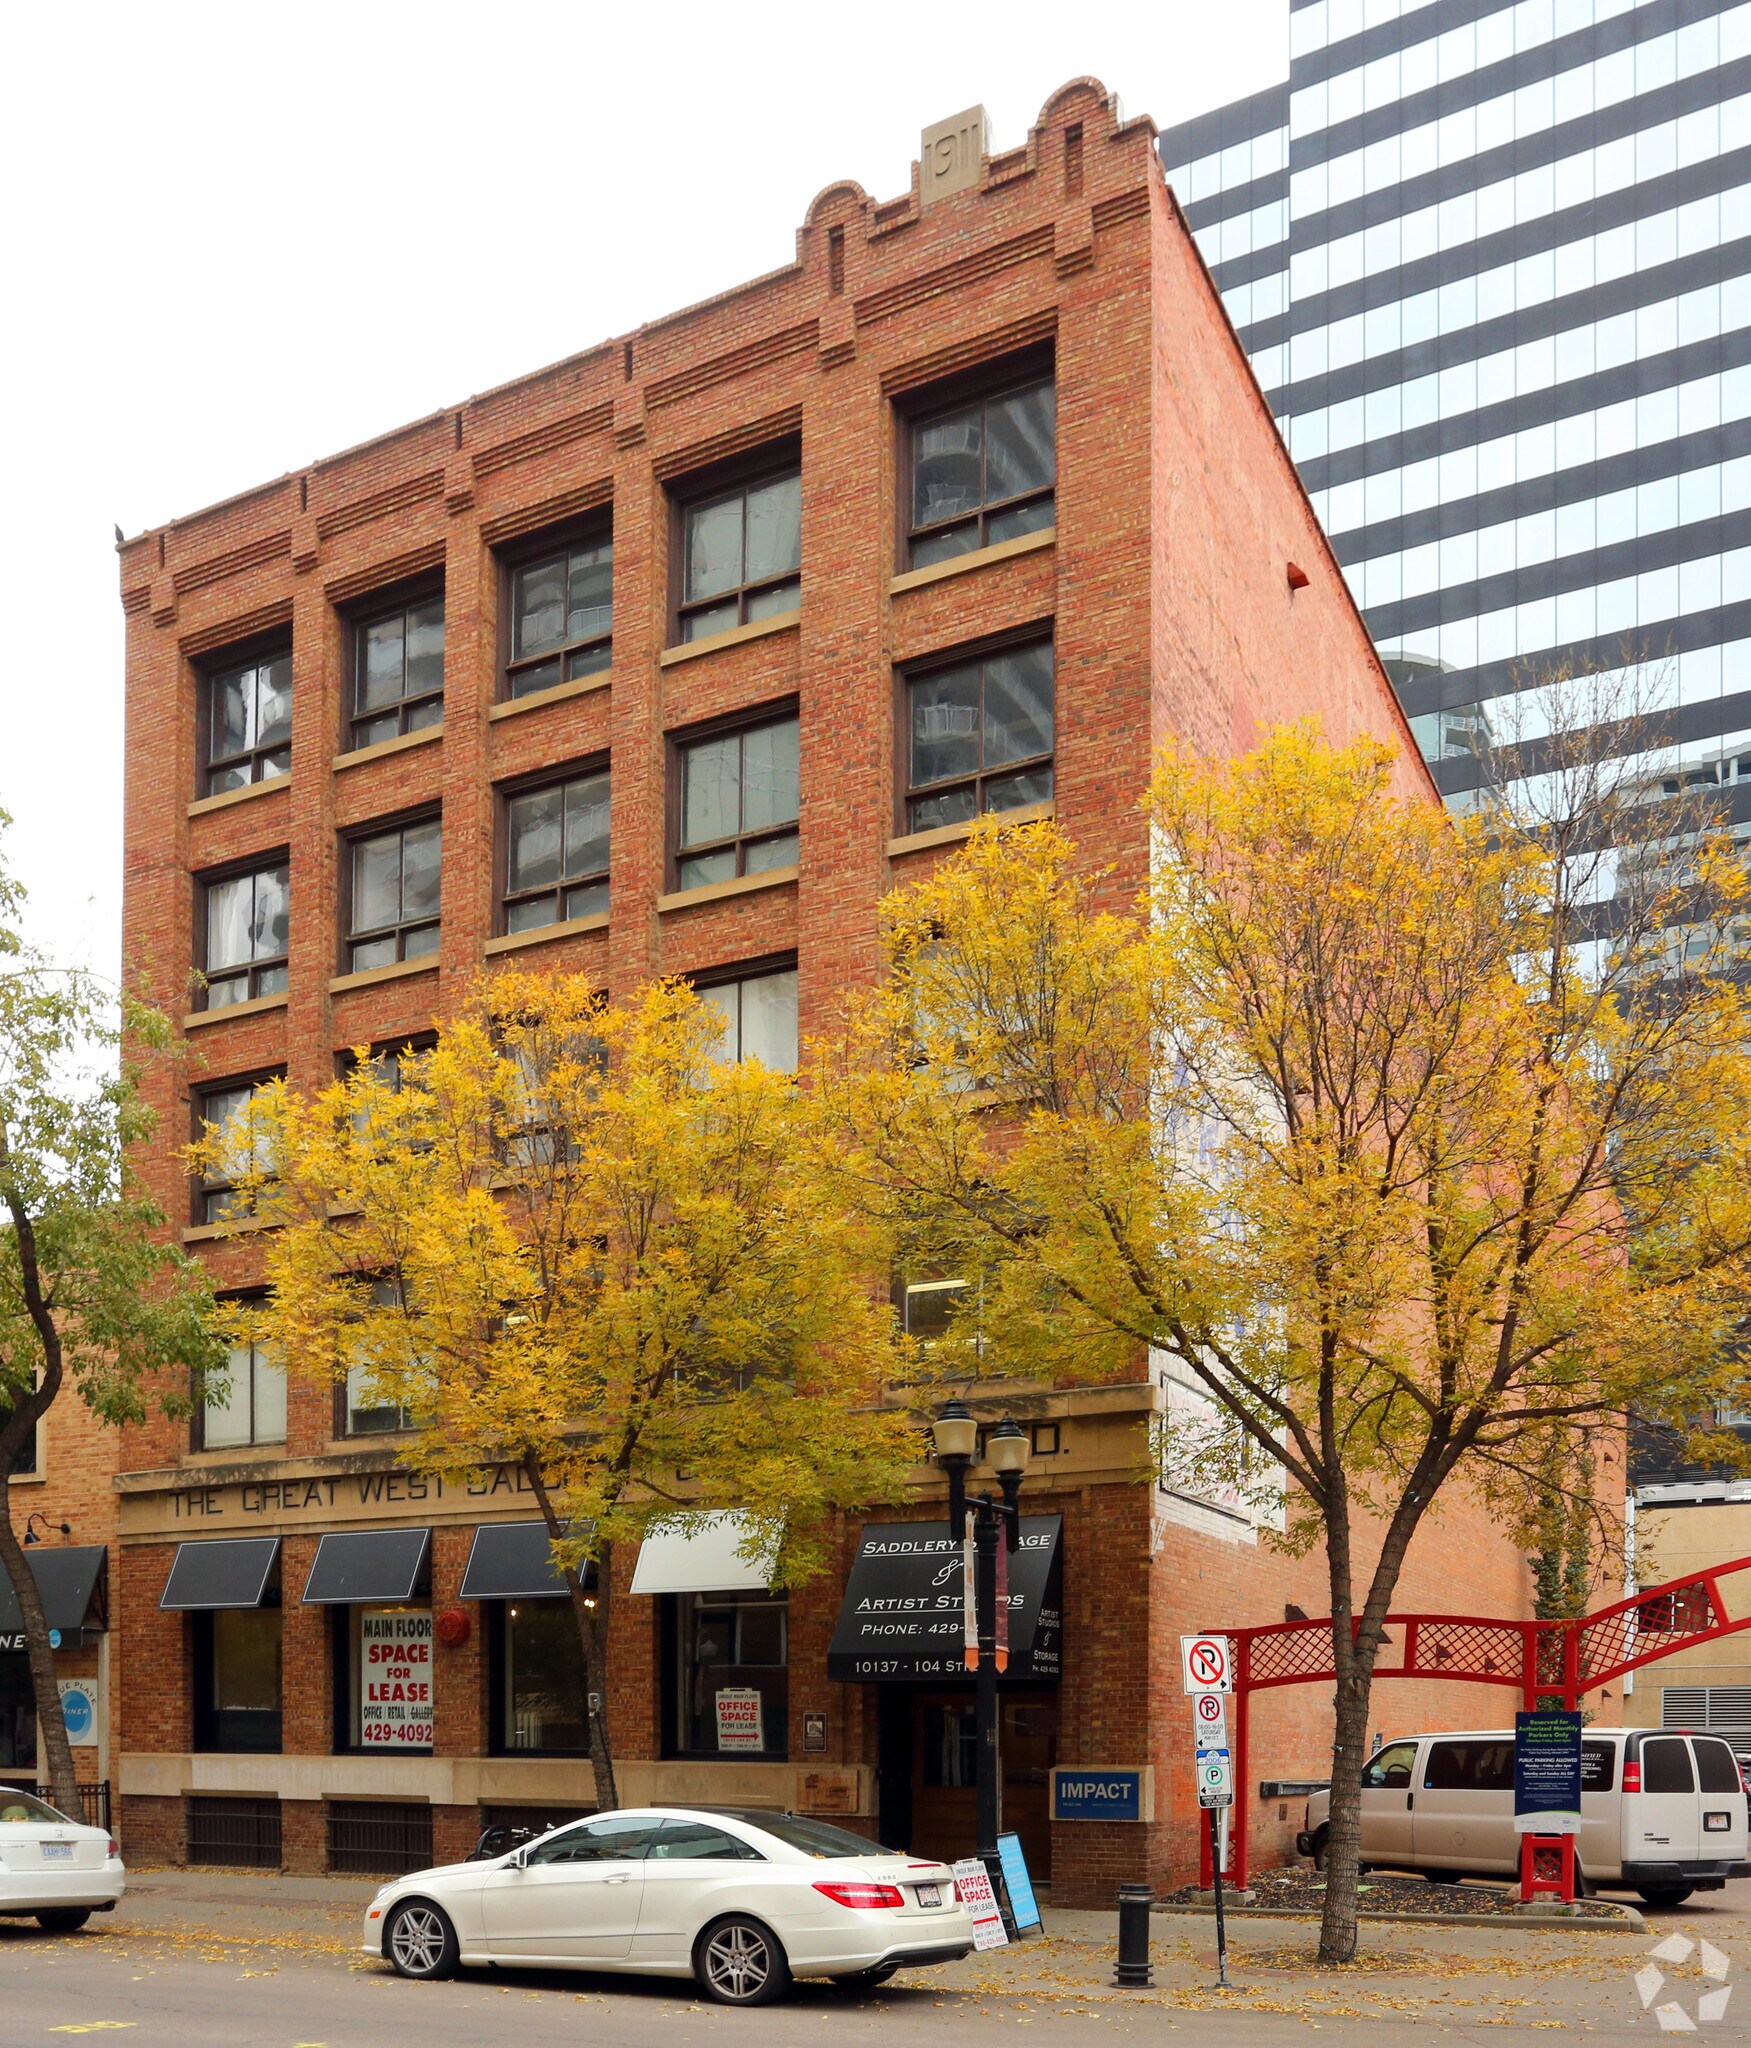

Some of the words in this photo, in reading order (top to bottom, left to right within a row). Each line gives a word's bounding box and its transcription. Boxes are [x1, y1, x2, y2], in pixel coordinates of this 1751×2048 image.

[169, 1488, 223, 1517] THE
[242, 1479, 341, 1514] GREAT
[354, 1471, 444, 1505] WEST
[862, 1539, 958, 1555] SADDLERY
[931, 1558, 965, 1587] &
[856, 1597, 929, 1611] ARTIST
[1040, 1608, 1059, 1619] ARTIST
[364, 1620, 393, 1637] MAIN
[396, 1618, 432, 1637] FLOOR
[860, 1624, 923, 1636] PHONE:
[368, 1644, 429, 1663] SPACE
[1033, 1649, 1059, 1662] STORAGE
[855, 1660, 899, 1673] 10137
[915, 1660, 941, 1673] 104
[386, 1668, 411, 1679] FOR
[74, 1681, 97, 1705] PLATE
[368, 1683, 429, 1702] LEASE
[363, 1706, 382, 1719] OFFICE
[387, 1706, 406, 1719] RETAIL
[718, 1701, 758, 1711] OFFICE
[721, 1712, 757, 1721] SPACE
[364, 1723, 432, 1742] 429-4092
[721, 1722, 735, 1730] FOR
[736, 1722, 757, 1730] LEASE
[1553, 1725, 1579, 1733] Monthly
[1210, 1769, 1219, 1781] P
[1061, 1782, 1132, 1799] IMPACT
[959, 1874, 989, 1890] OFFICE
[964, 1888, 992, 1903] SPACE
[968, 1904, 979, 1914] FOR
[980, 1901, 996, 1912] LEASE
